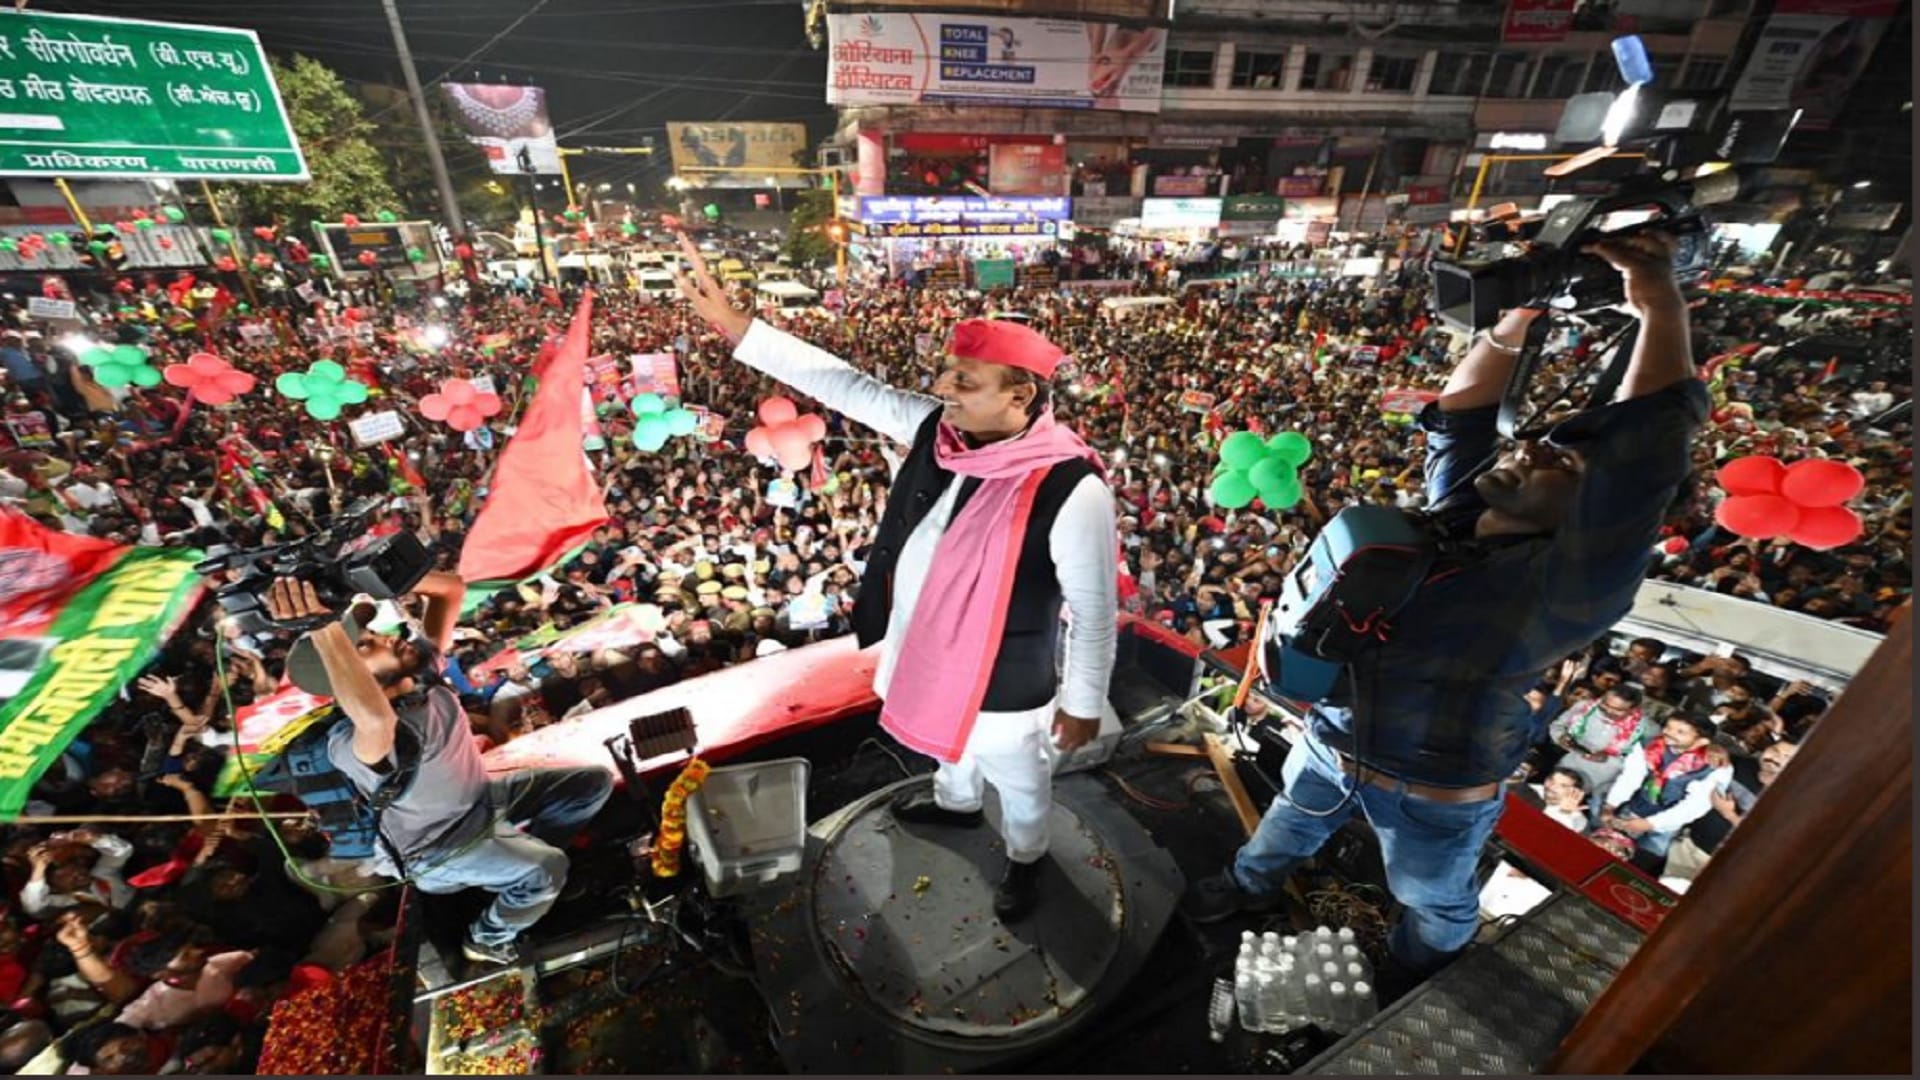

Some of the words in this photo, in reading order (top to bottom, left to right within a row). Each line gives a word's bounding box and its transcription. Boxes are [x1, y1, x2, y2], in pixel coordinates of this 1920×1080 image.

[943, 28, 985, 40] TOTAL
[21, 28, 138, 68] सीरगोवर्धन
[943, 66, 1033, 80] REPLACEMENT
[178, 154, 277, 172] वाराणसी
